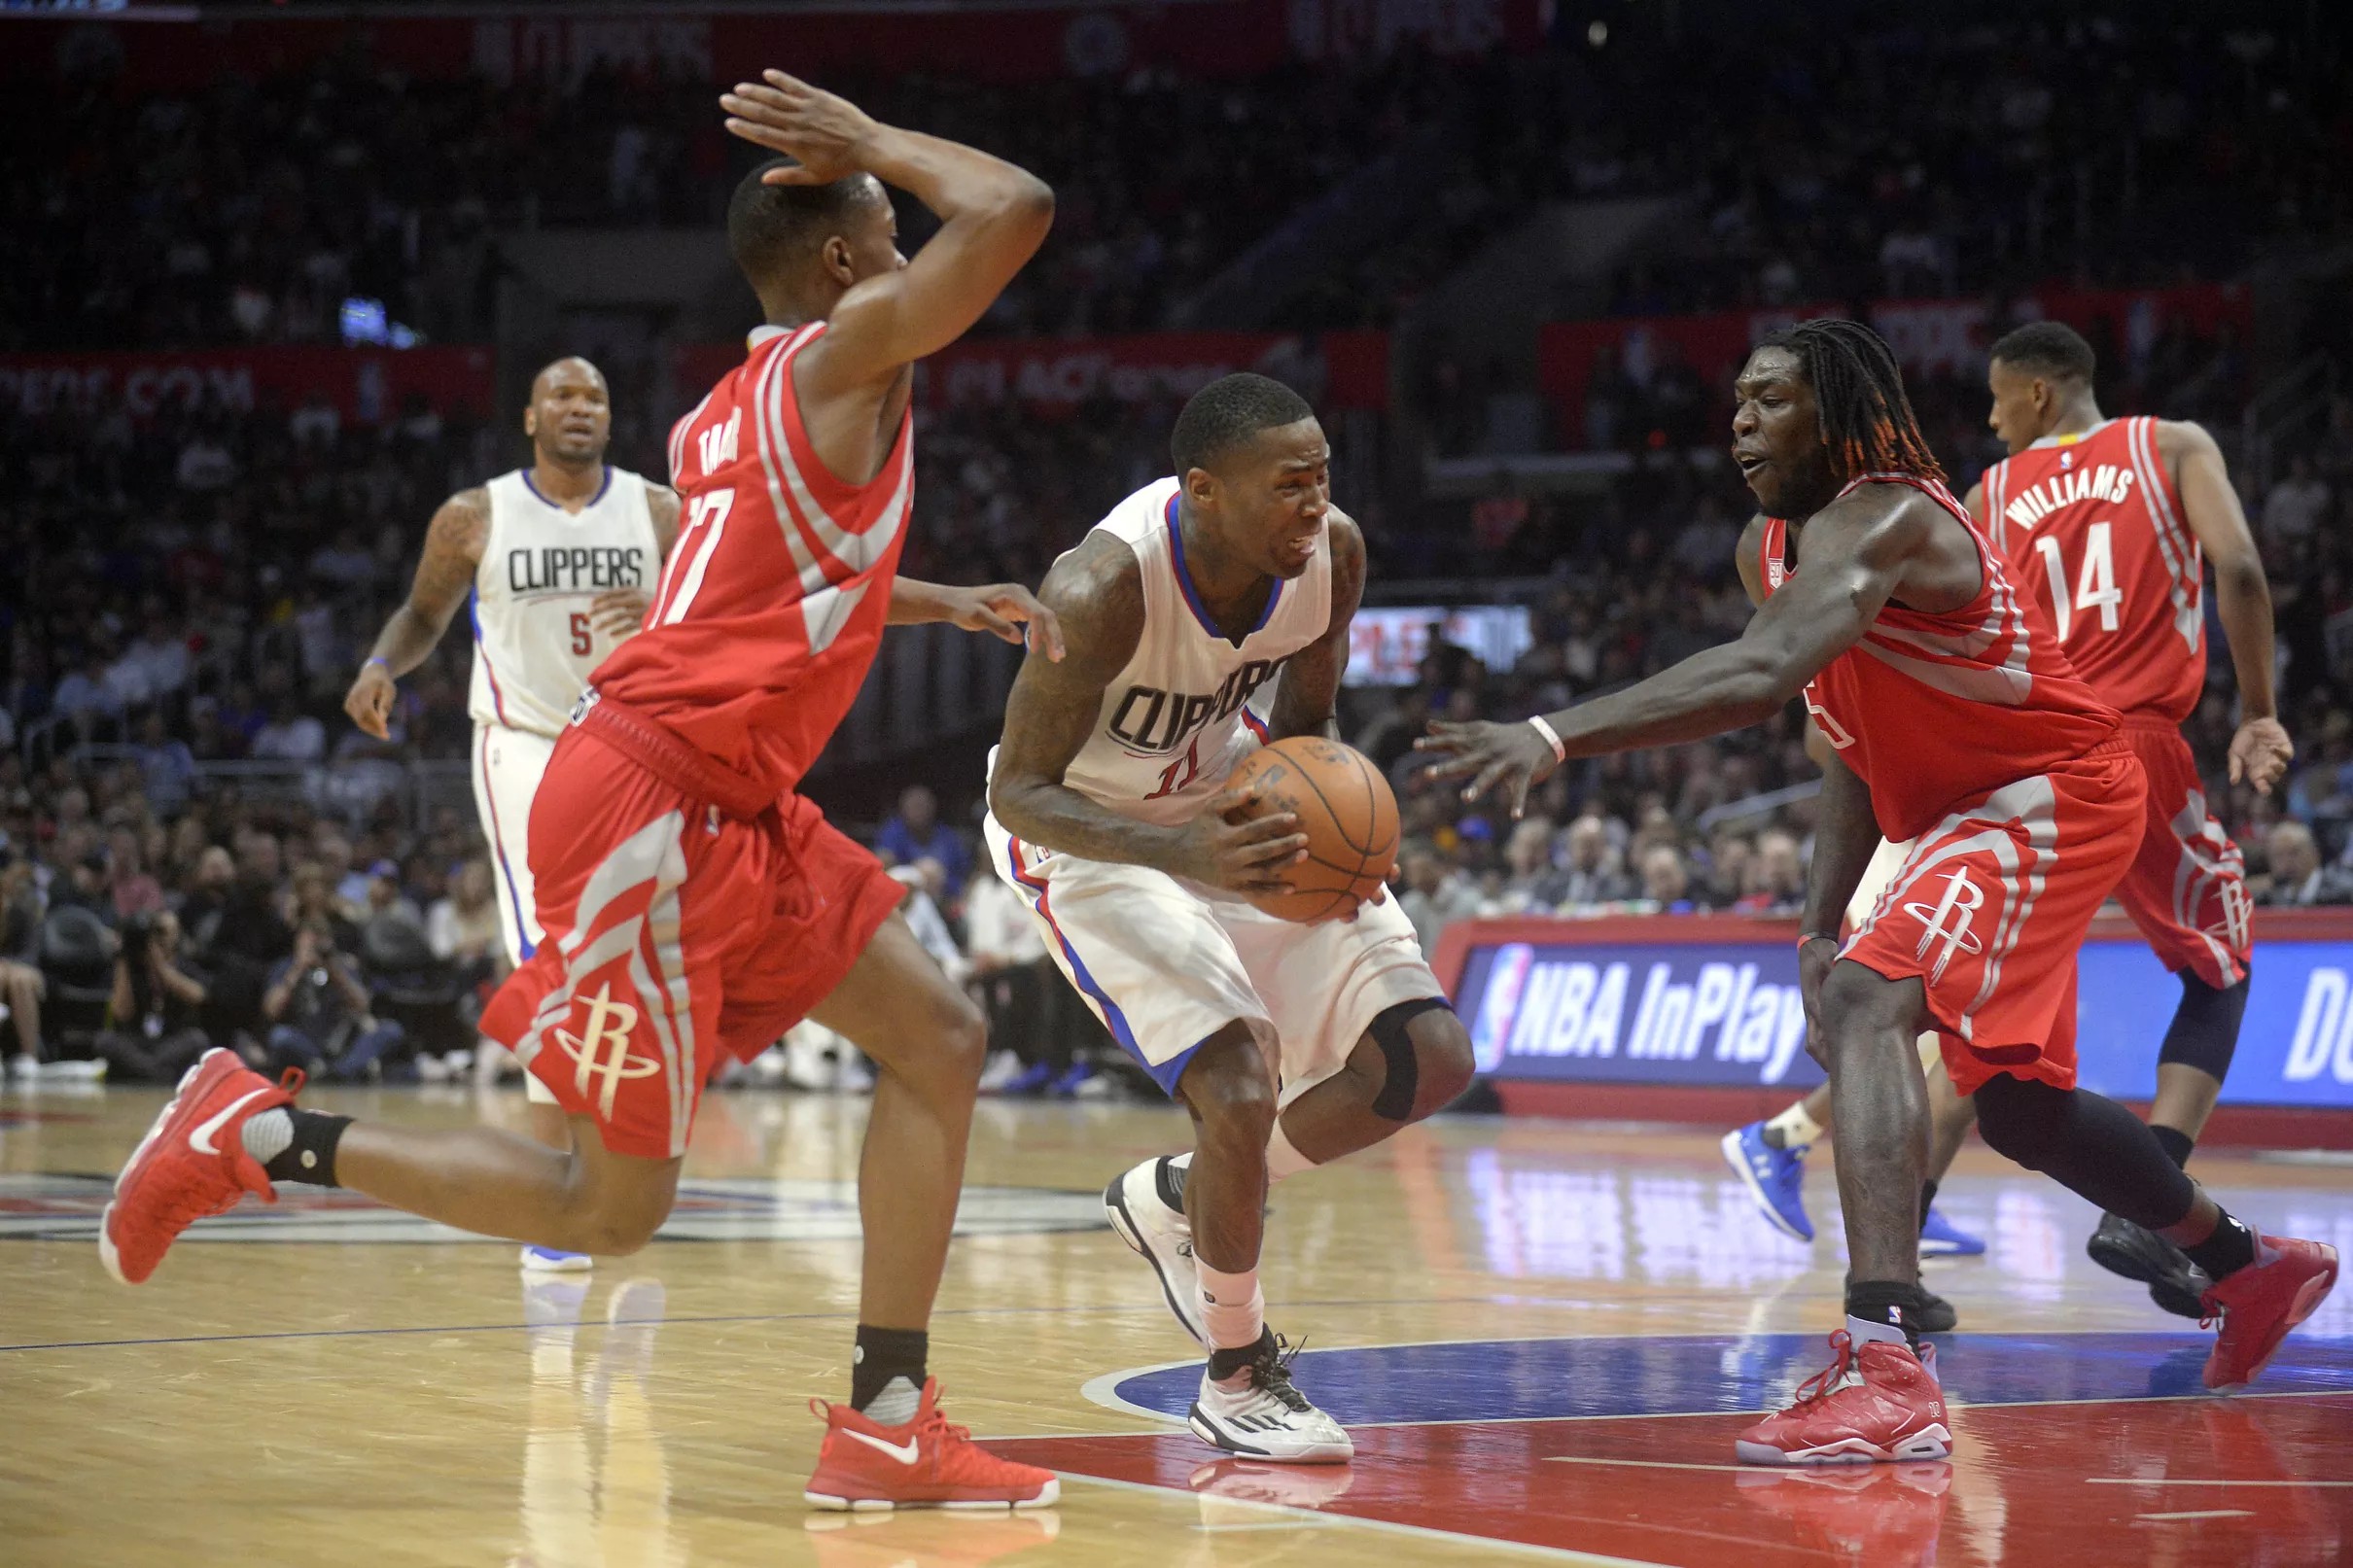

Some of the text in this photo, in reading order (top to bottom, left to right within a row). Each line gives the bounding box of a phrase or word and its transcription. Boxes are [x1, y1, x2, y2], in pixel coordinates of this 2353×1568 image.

[2005, 464, 2134, 531] WILLIAMS
[509, 546, 643, 592] CLIPPERS
[648, 487, 736, 631] 17
[2035, 521, 2123, 644] 14
[570, 611, 592, 657] 5
[1143, 731, 1203, 801] 11
[1509, 960, 1807, 1085] NBA InPlay
